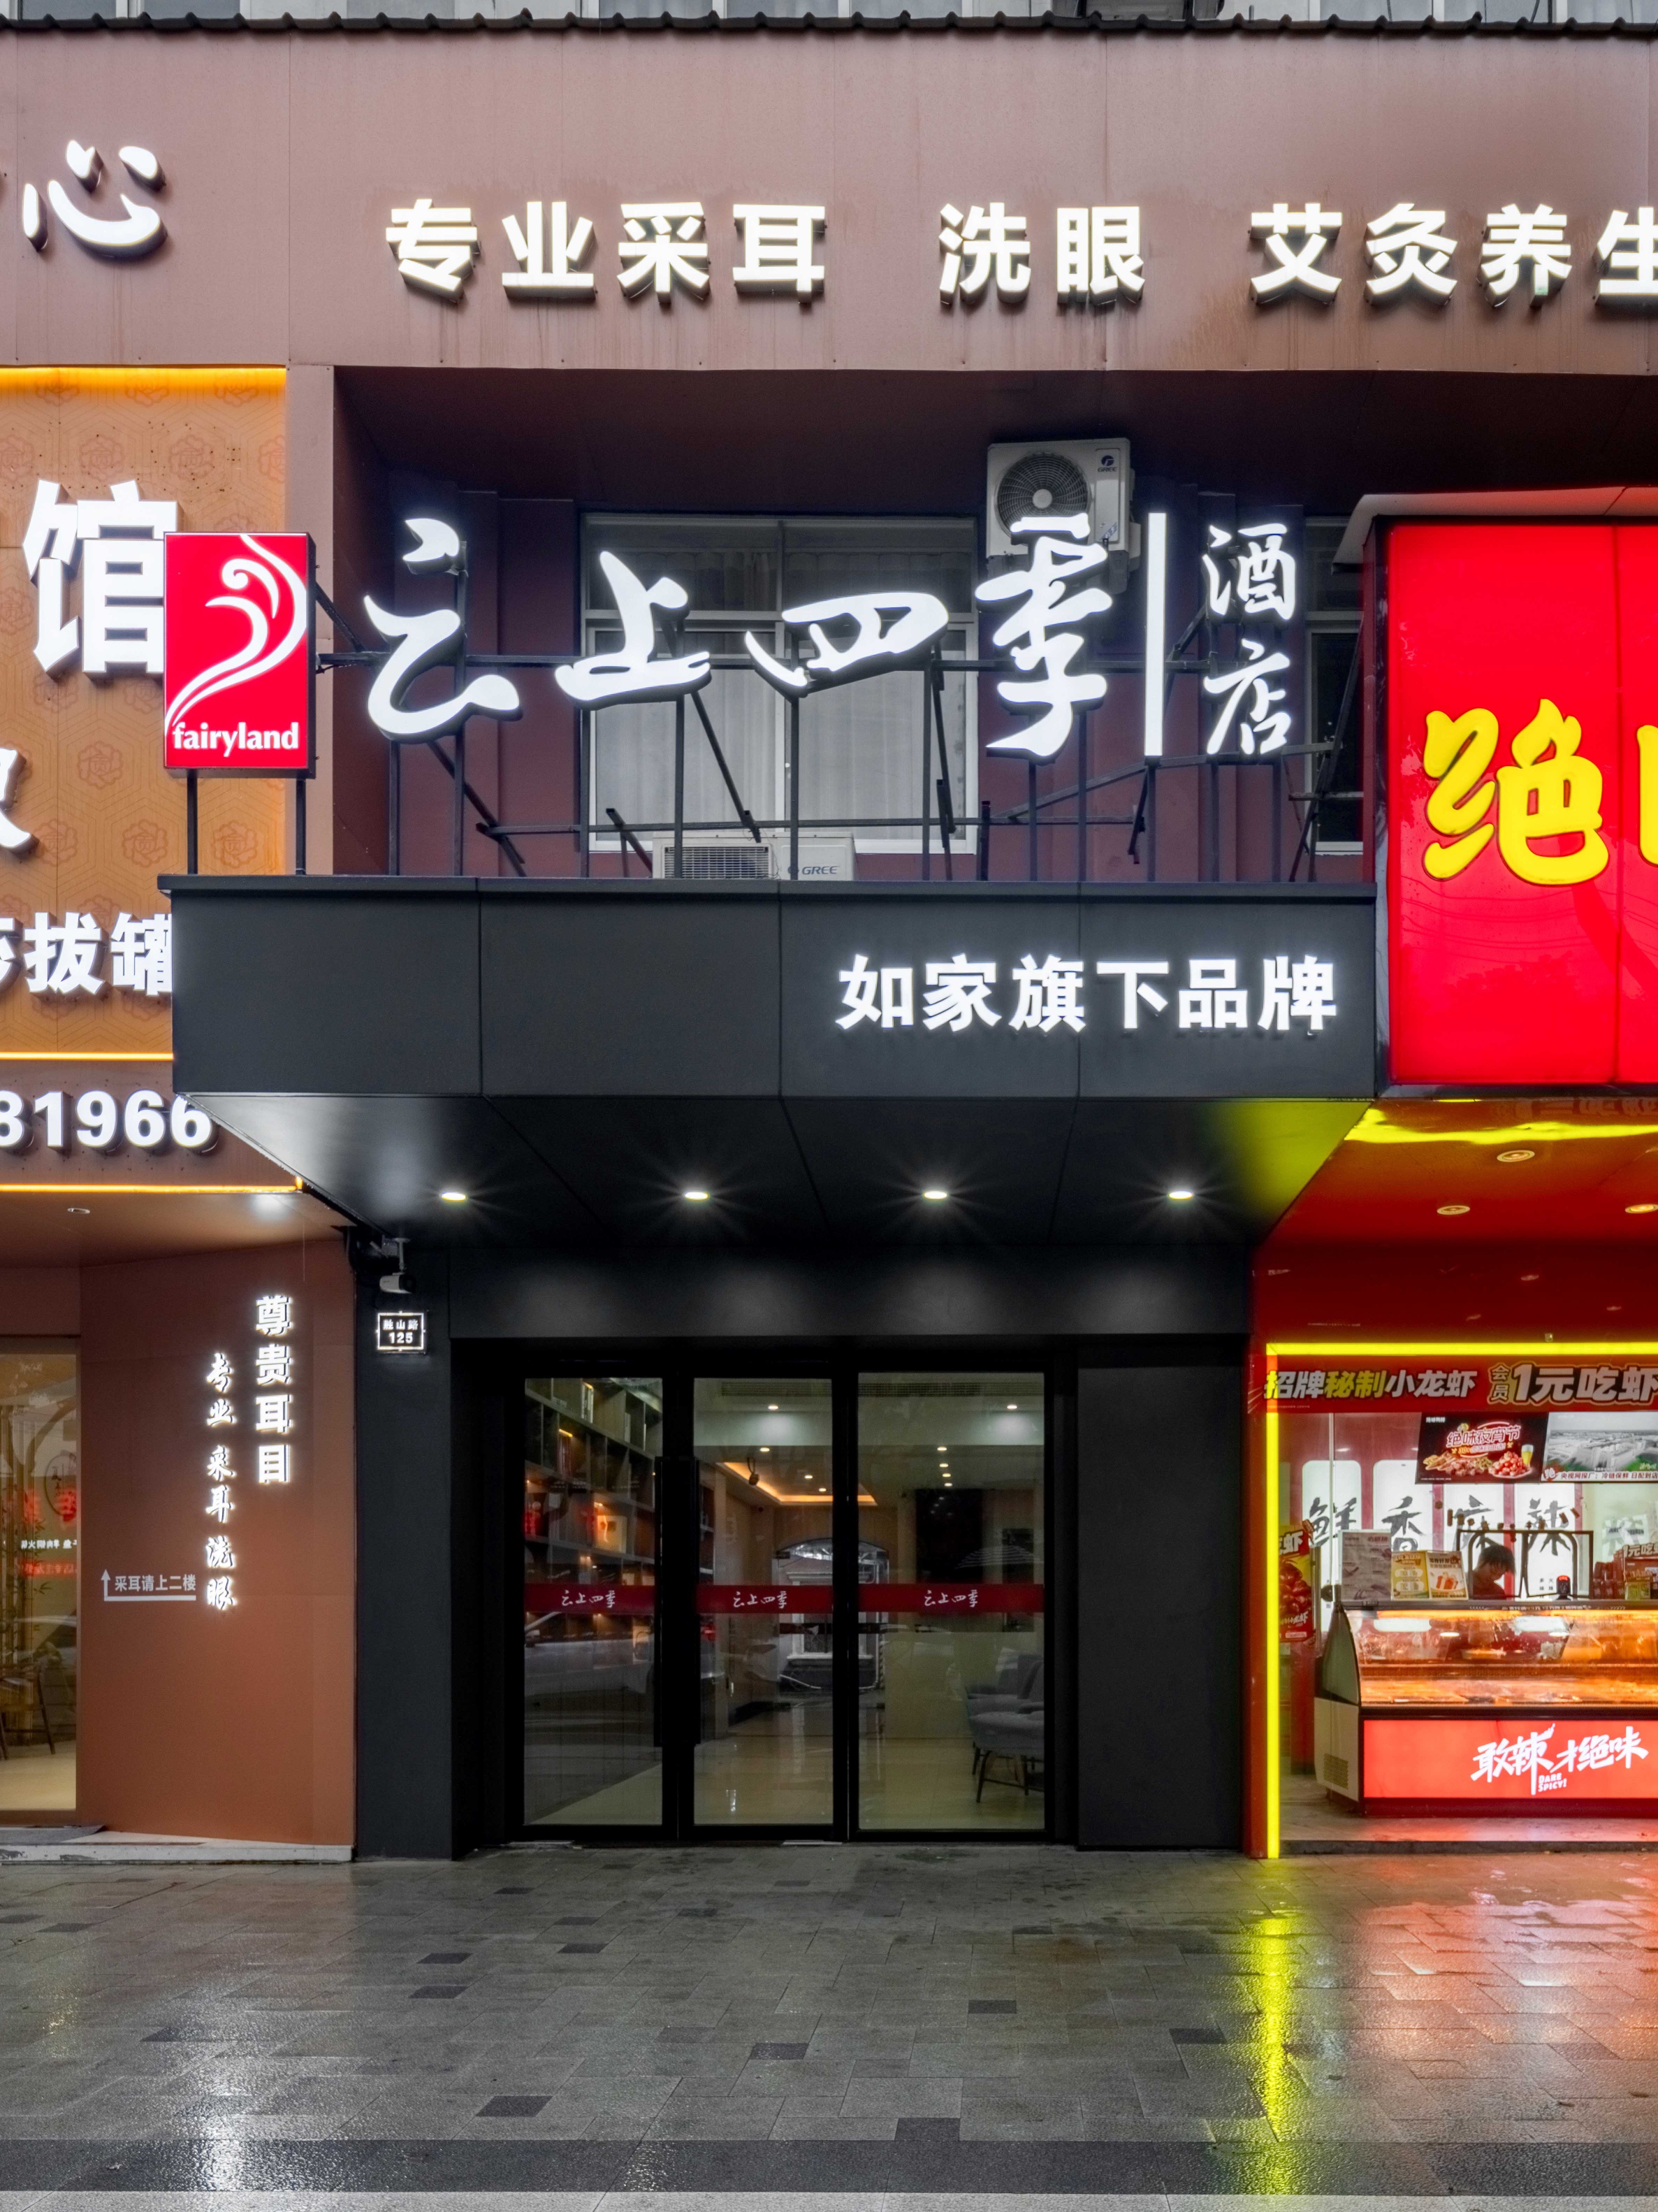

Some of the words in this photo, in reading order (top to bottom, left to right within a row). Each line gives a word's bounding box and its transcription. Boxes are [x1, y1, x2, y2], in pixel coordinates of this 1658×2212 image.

[22, 140, 161, 246] 心
[386, 199, 825, 294] 专业采耳
[938, 202, 1145, 295] 洗眼
[1251, 203, 1658, 297] 艾灸养生
[22, 479, 178, 674] 馆
[363, 512, 1113, 757] 云上四季
[1202, 523, 1296, 756] 酒店
[172, 721, 299, 757] fairyland
[1423, 698, 1658, 886] 绝
[801, 865, 841, 875] GREE
[0, 911, 173, 995] 拔罐
[835, 953, 1337, 1032] 如家旗下品牌
[388, 1331, 414, 1344] 125
[255, 1294, 293, 1484] 尊贵耳目
[1264, 1370, 1478, 1398] 招牌秘制小龙虾
[1446, 1424, 1522, 1448] 绝味夜宵节
[115, 1575, 196, 1592] 采耳请上二楼
[561, 1589, 616, 1608] 云上四季
[733, 1591, 787, 1609] 云上四季
[924, 1589, 978, 1607] 云上四季
[1538, 1772, 1562, 1784] DARE
[1538, 1778, 1568, 1792] SPICY!
